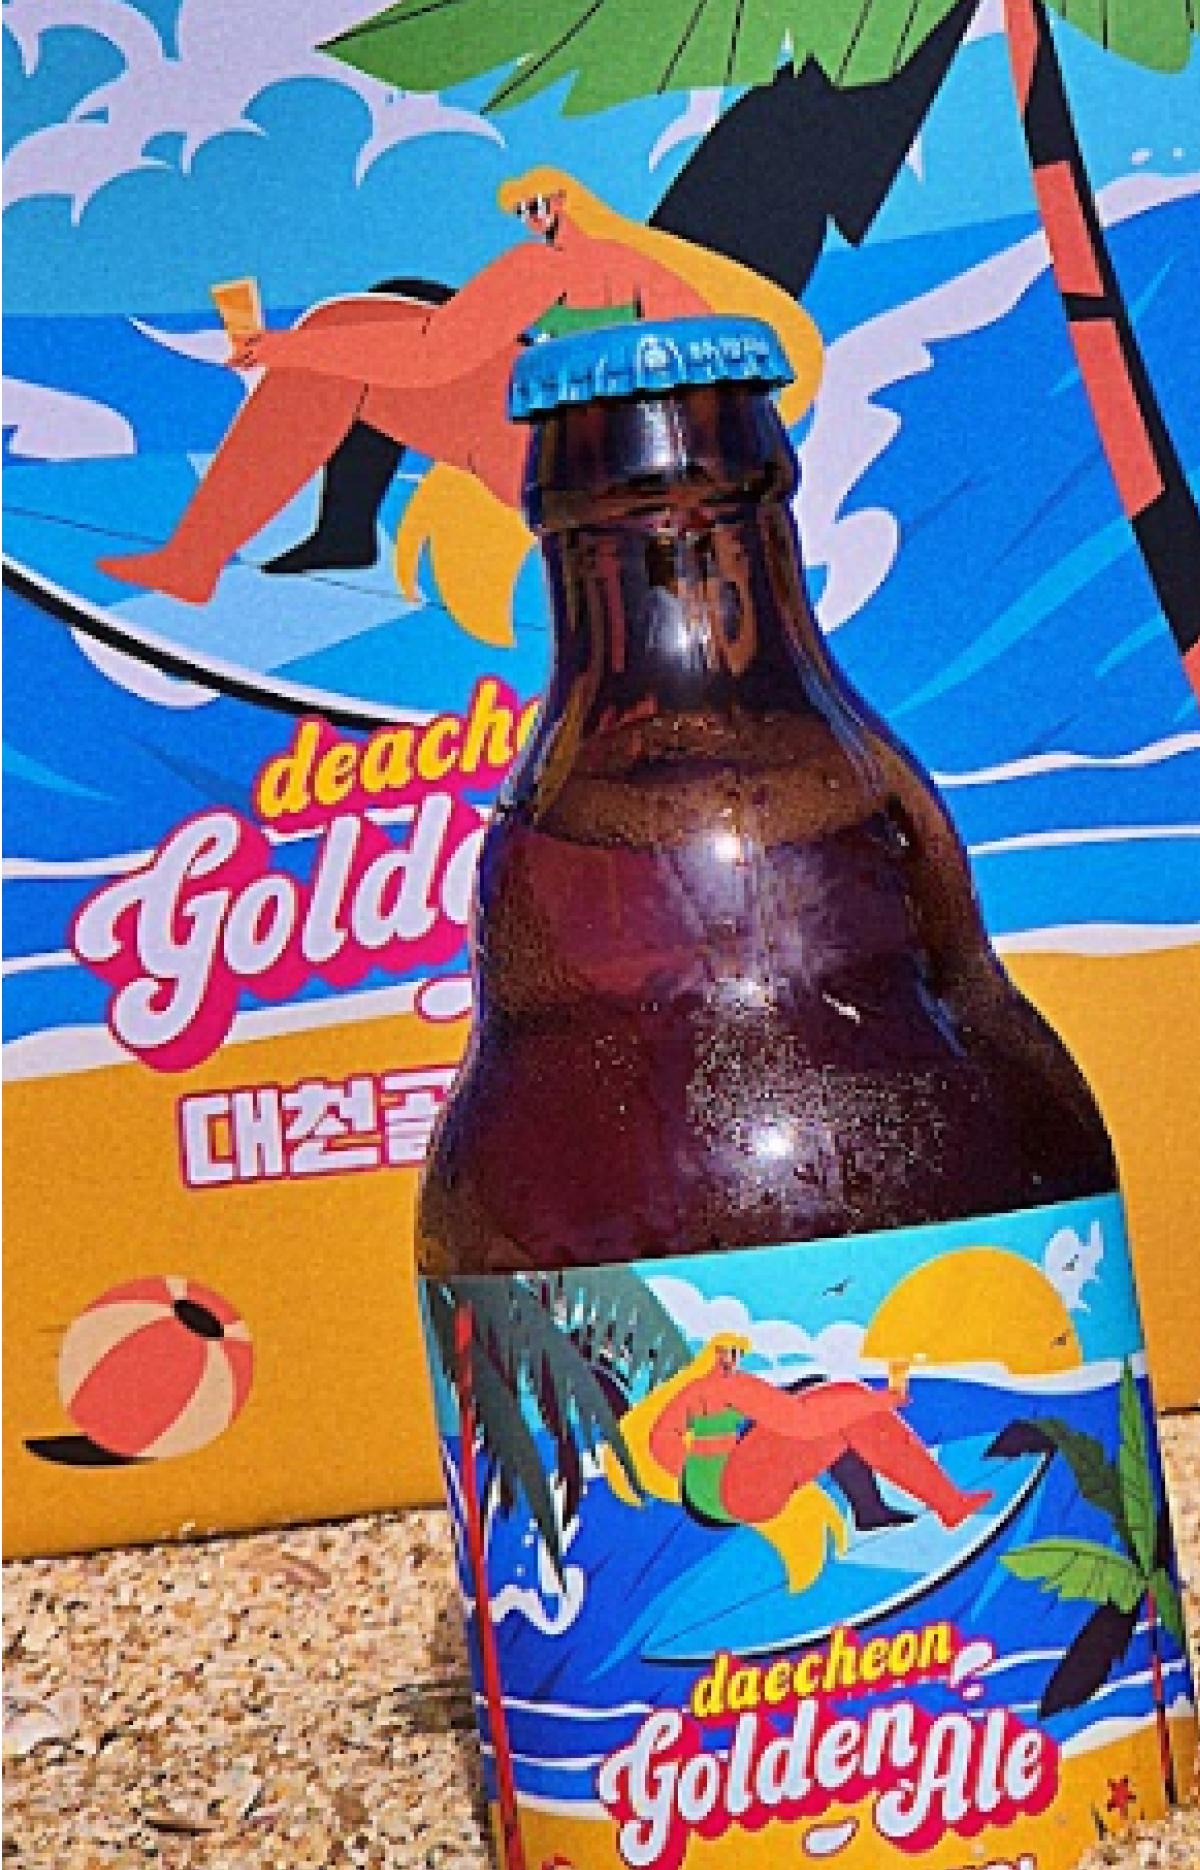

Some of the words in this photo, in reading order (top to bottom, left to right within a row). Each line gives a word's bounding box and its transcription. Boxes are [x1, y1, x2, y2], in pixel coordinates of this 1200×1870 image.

[690, 1620, 952, 1720] daecheon
[600, 1698, 920, 1868] Golden
[870, 1706, 1052, 1848] Ale
